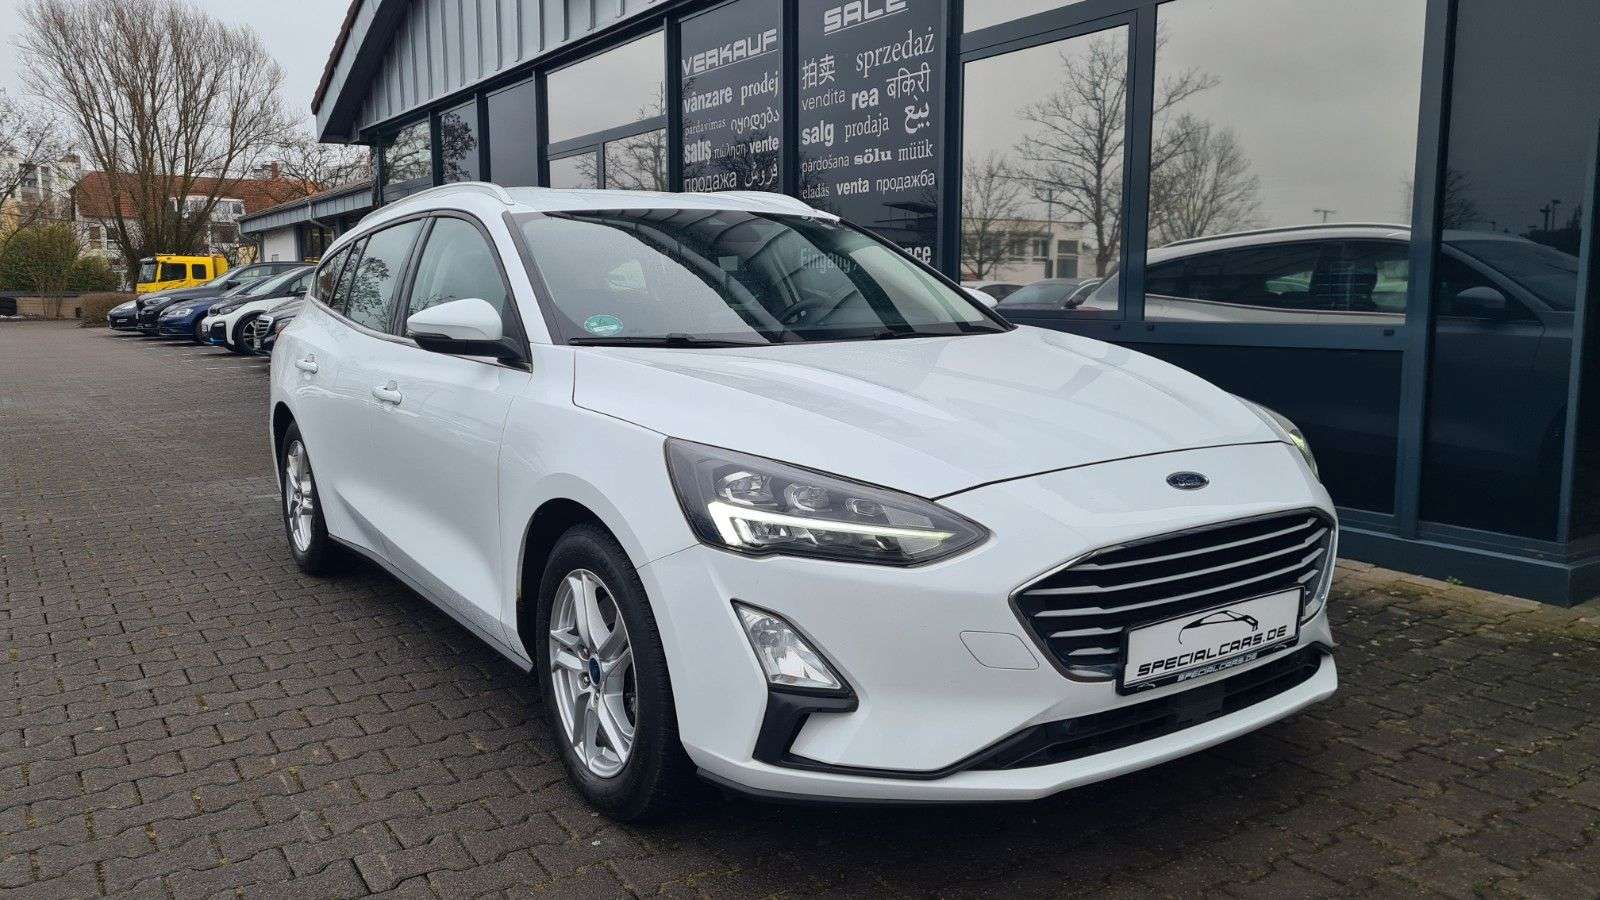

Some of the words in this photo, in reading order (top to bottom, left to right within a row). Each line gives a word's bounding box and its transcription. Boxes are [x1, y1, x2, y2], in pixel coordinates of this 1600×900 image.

[824, 0, 906, 33] SALE
[681, 28, 777, 76] VERKAUF
[856, 26, 935, 79] sprzedaż
[802, 53, 836, 90] 拍卖
[683, 91, 733, 114] vânzare
[740, 70, 779, 106] prodej
[801, 88, 846, 111] vendita
[851, 87, 879, 111] rea
[749, 135, 779, 154] vente
[801, 119, 835, 147] salg
[844, 112, 890, 143] prodaja
[853, 147, 893, 165] sölu
[898, 139, 934, 162] müük
[684, 171, 737, 193] продажа
[836, 178, 870, 195] venta
[876, 168, 936, 195] продажба
